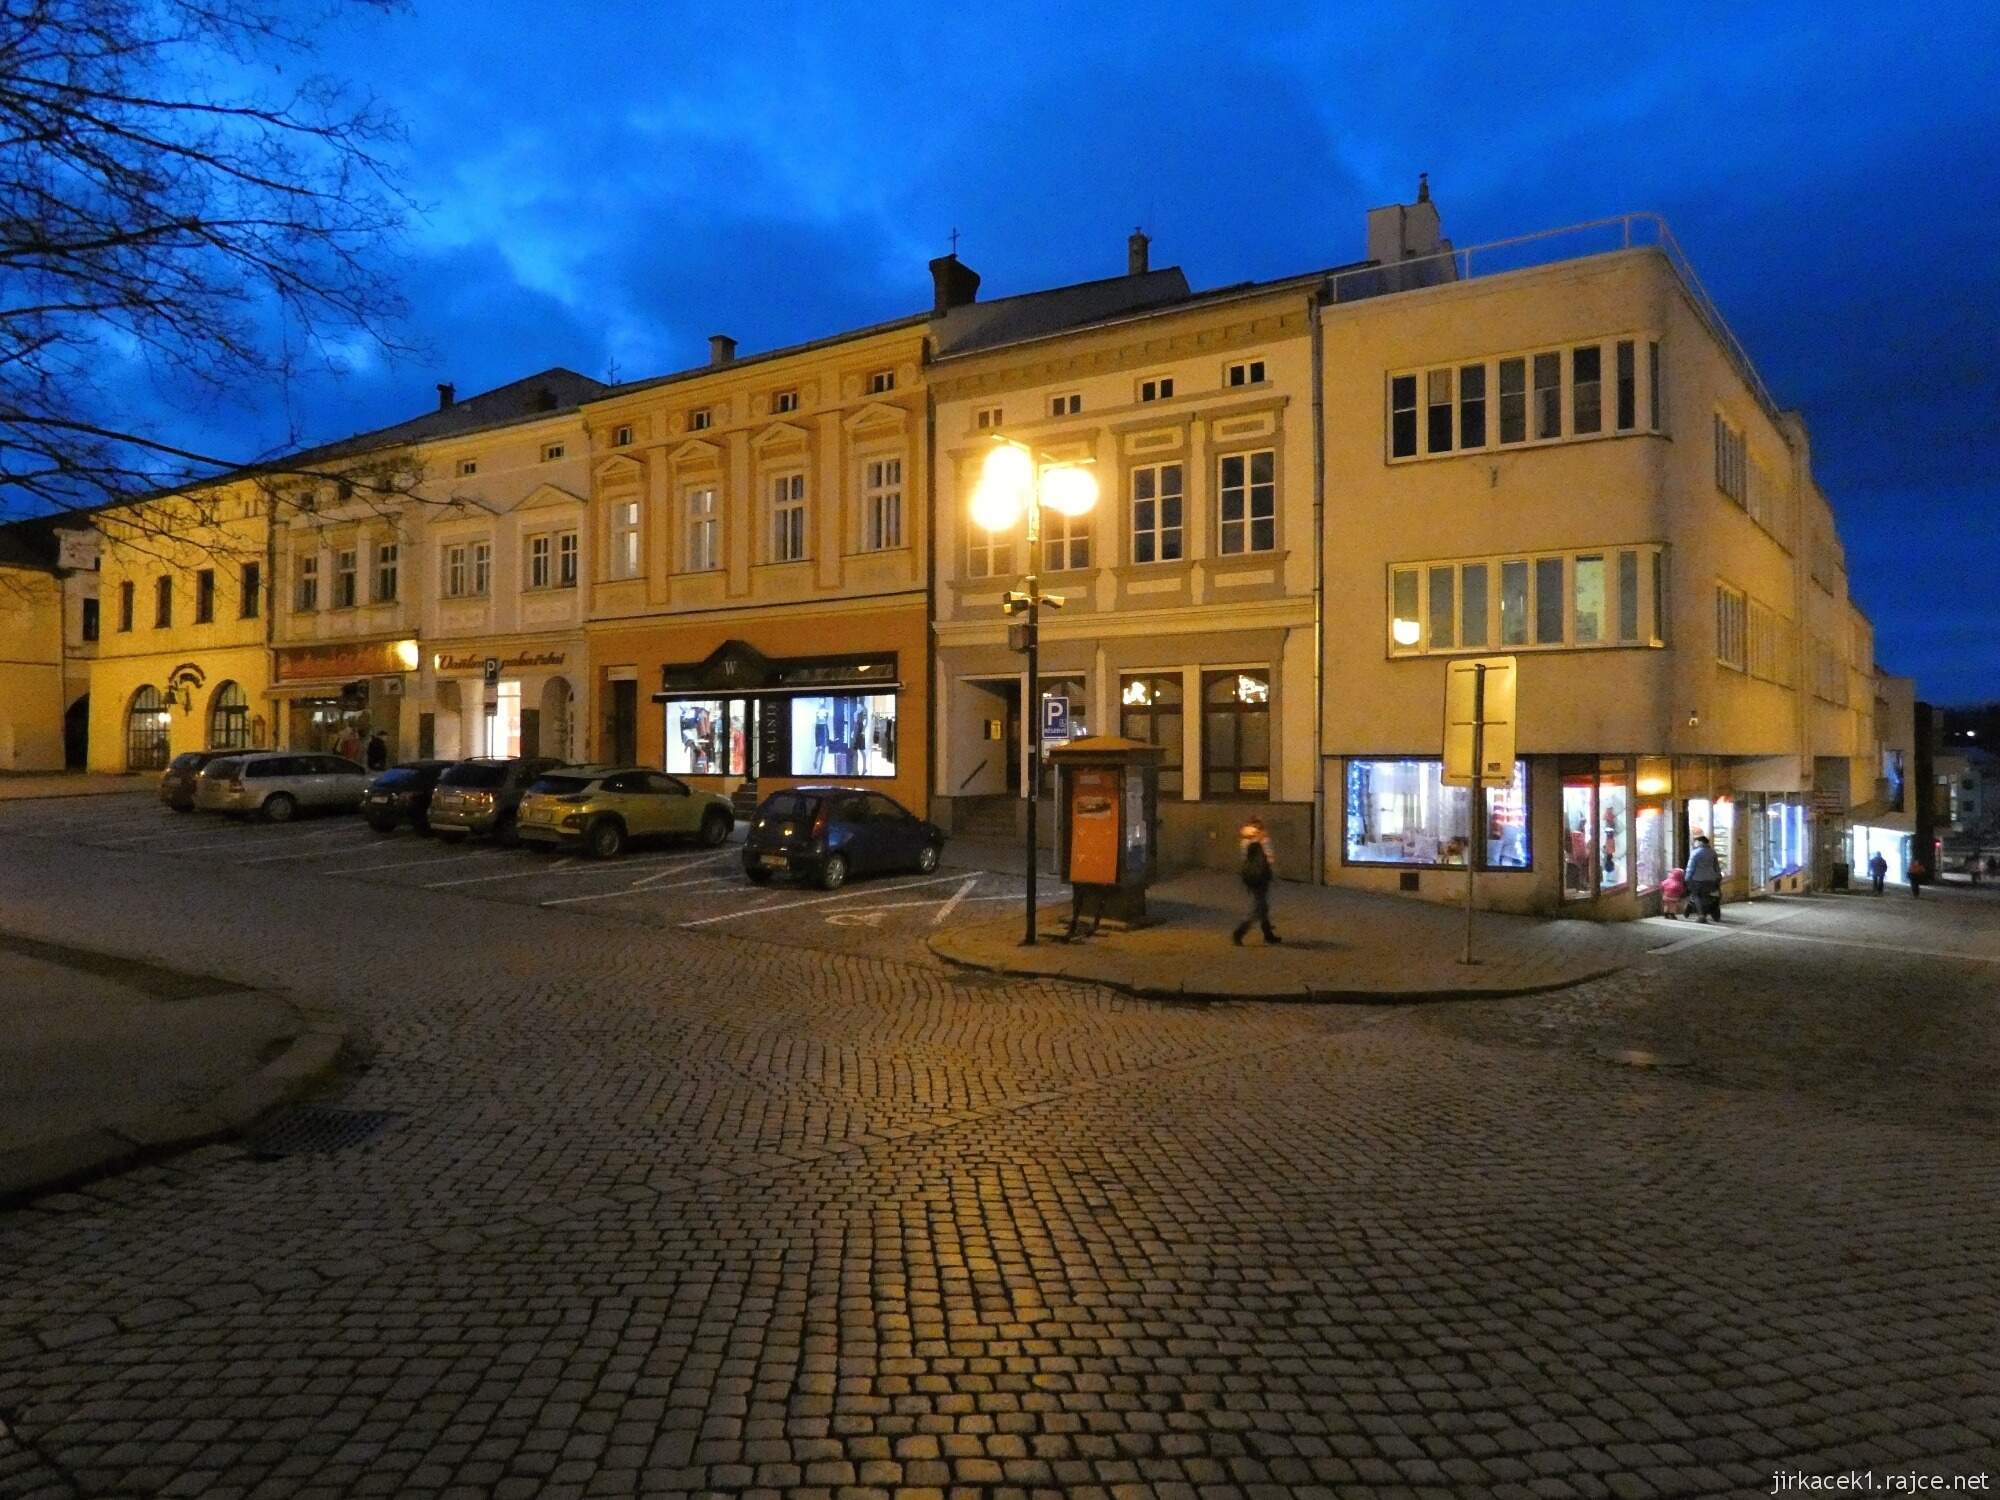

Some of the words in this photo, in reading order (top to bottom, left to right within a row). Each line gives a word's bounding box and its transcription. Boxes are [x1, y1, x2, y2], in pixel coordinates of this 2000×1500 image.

[486, 660, 496, 678] P
[724, 661, 737, 675] W
[1048, 702, 1063, 725] P
